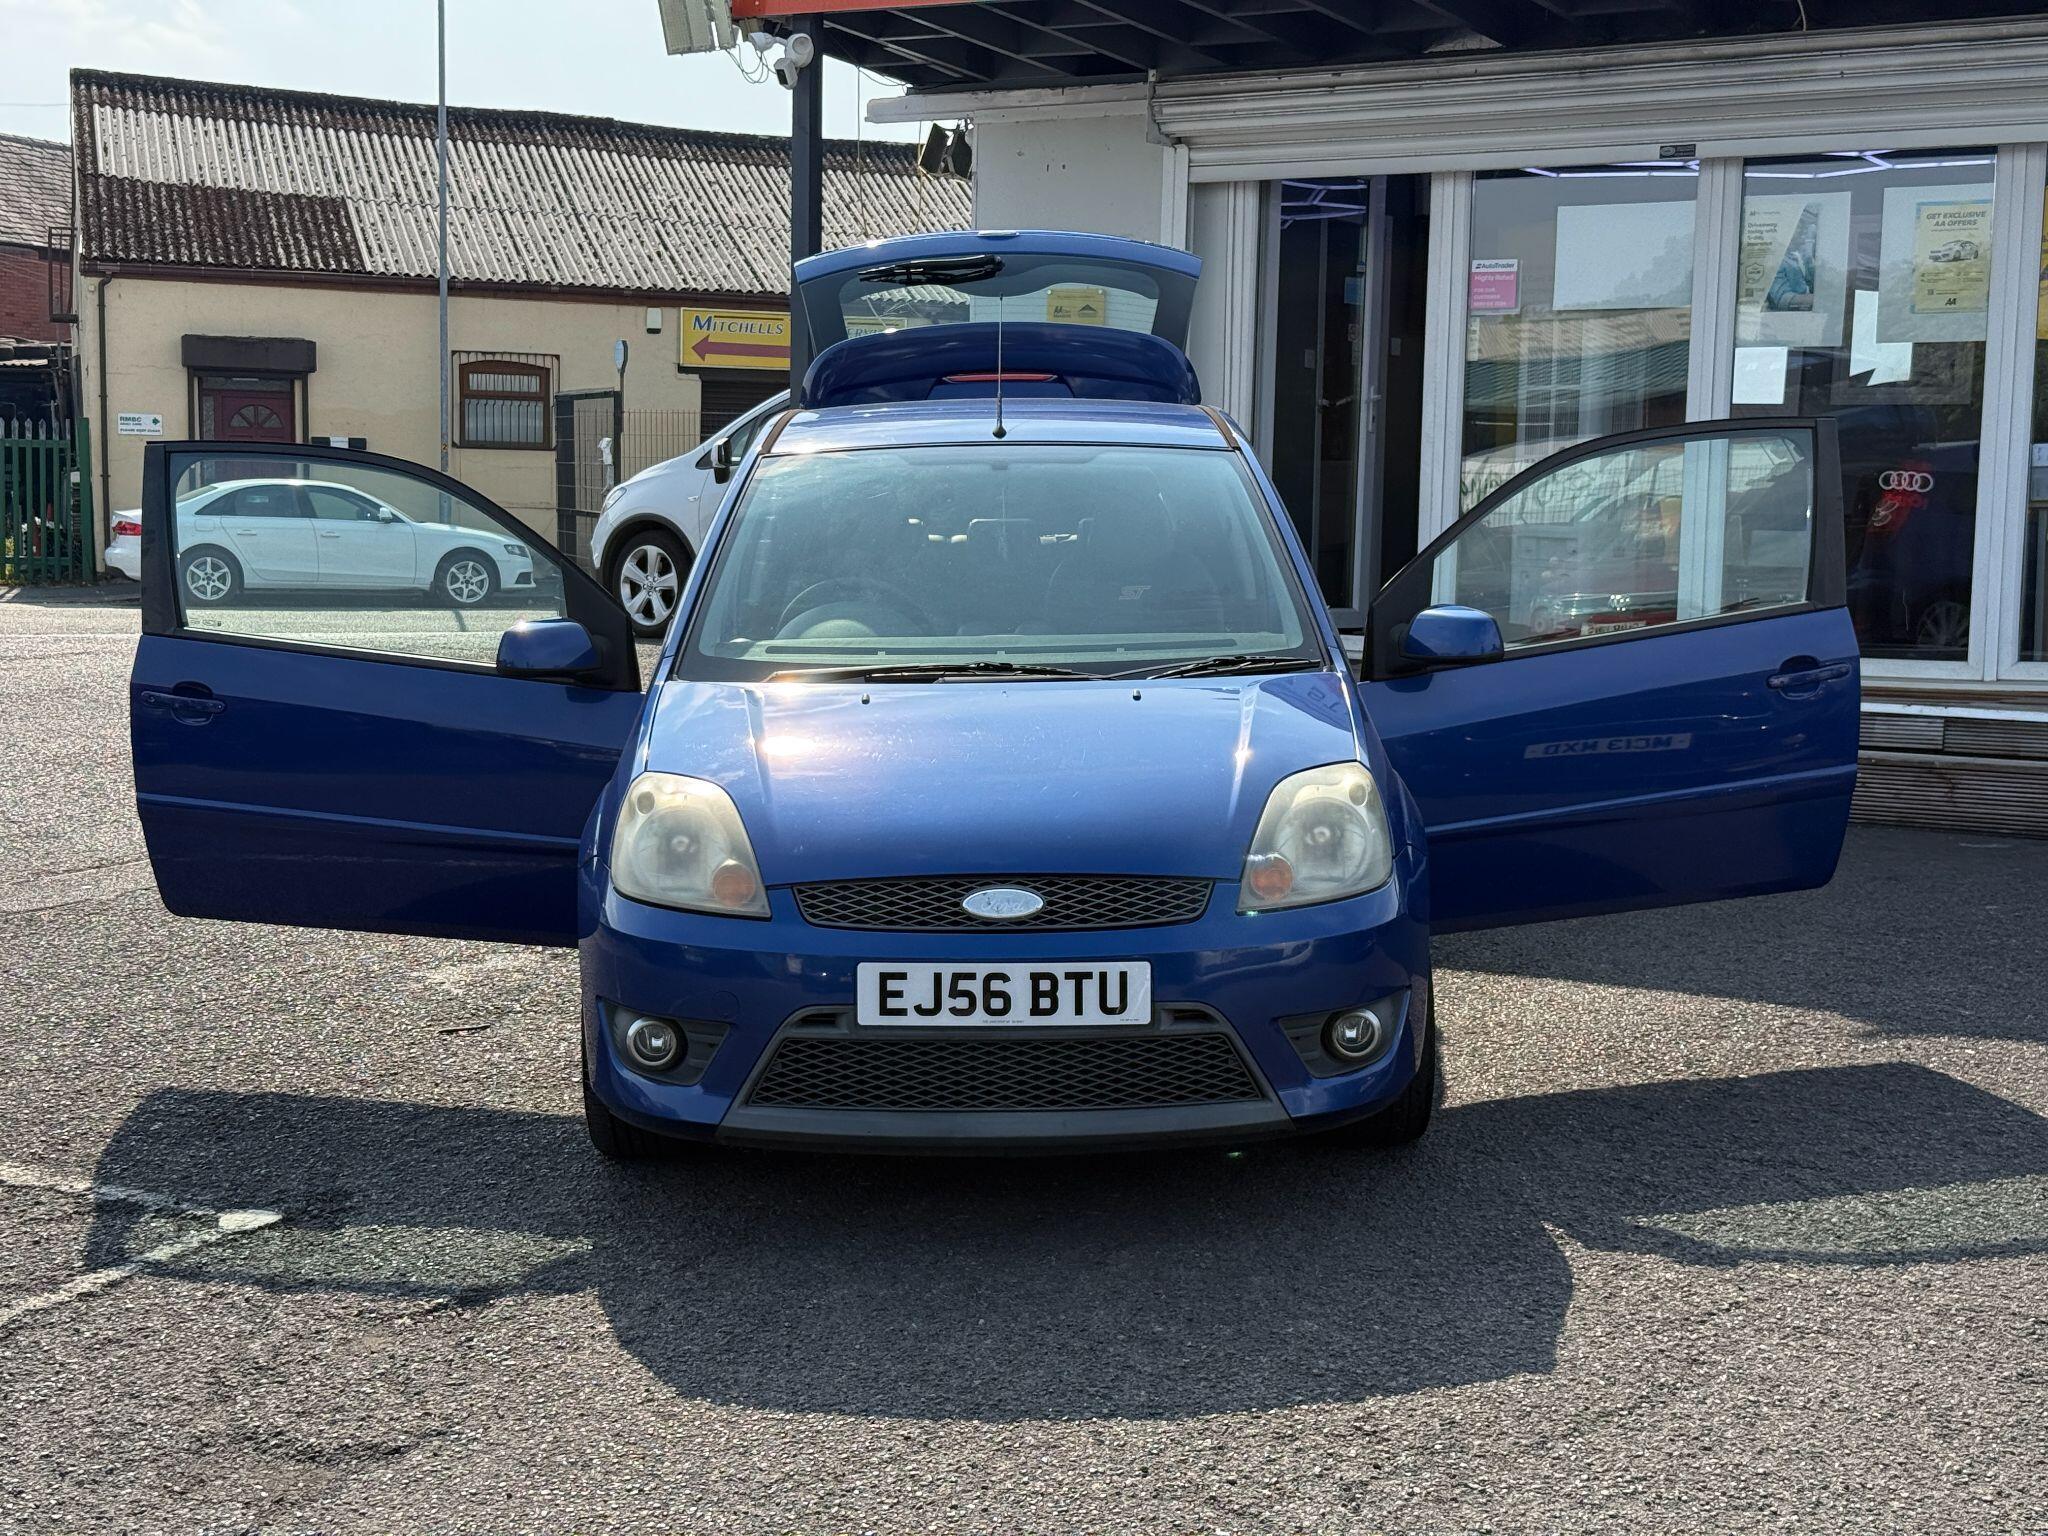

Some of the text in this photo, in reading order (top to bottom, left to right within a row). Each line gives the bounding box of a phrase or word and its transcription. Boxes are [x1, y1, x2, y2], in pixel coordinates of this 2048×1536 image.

[1945, 298, 1957, 306] AA
[1119, 585, 1152, 600] ST
[879, 971, 1128, 1016] EJ56 BTU
